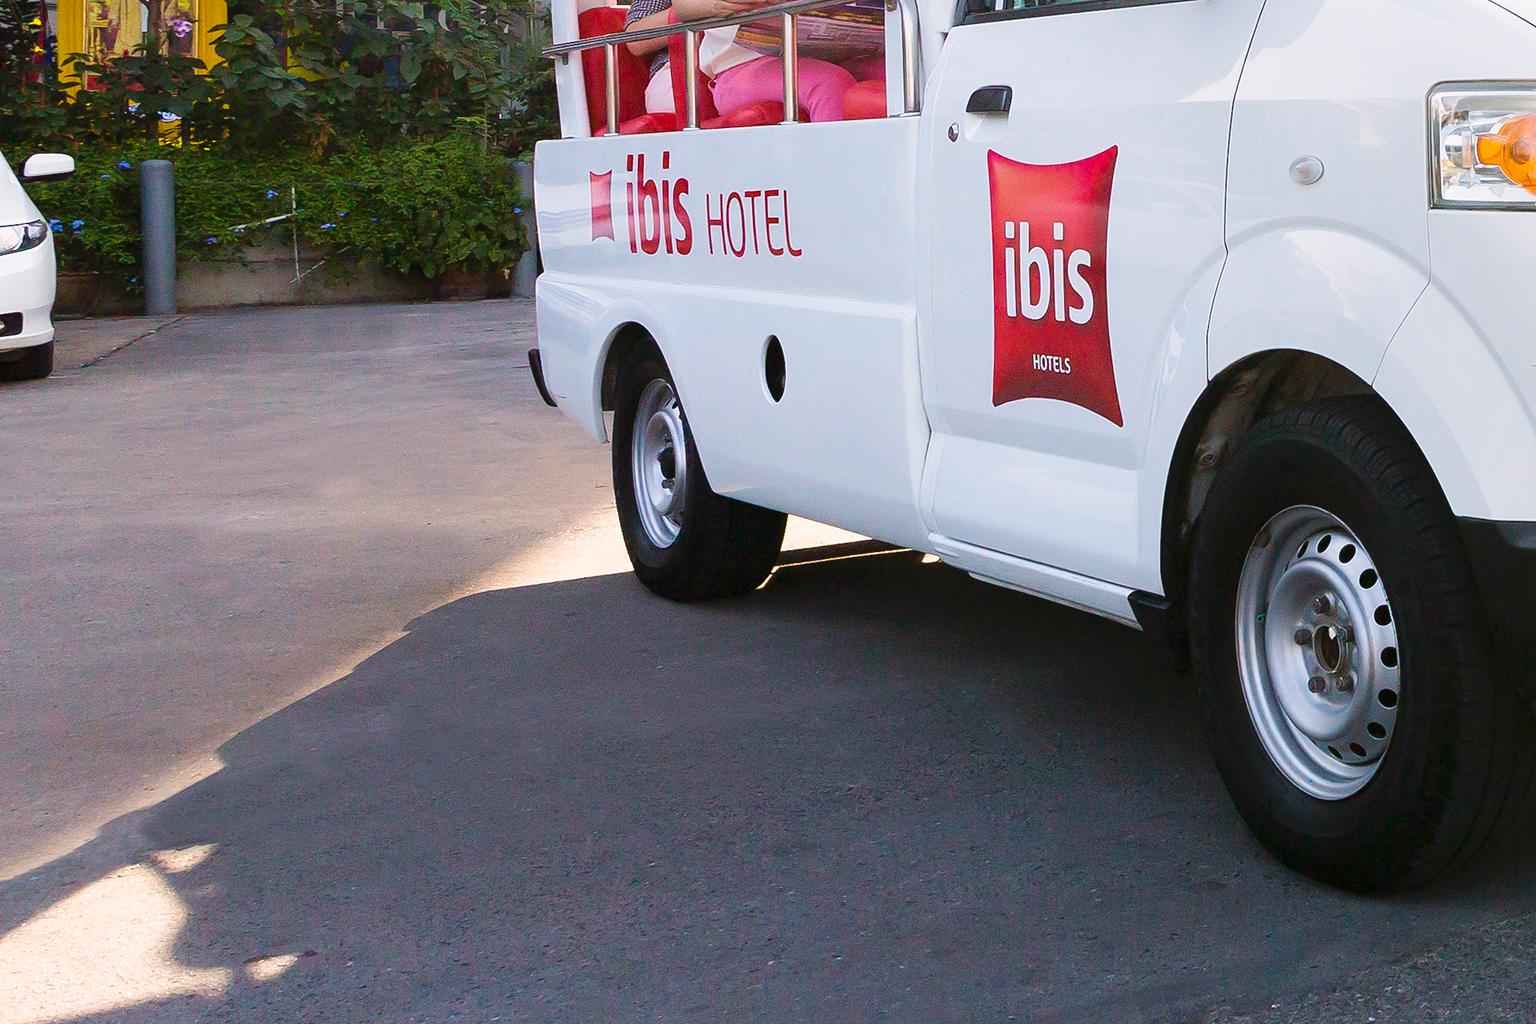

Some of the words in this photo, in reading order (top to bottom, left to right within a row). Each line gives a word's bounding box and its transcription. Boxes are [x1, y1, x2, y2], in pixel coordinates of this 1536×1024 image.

[624, 150, 694, 256] ibis
[705, 188, 803, 258] HOTEL
[1002, 220, 1096, 325] ibis
[1031, 352, 1072, 375] HOTELS
